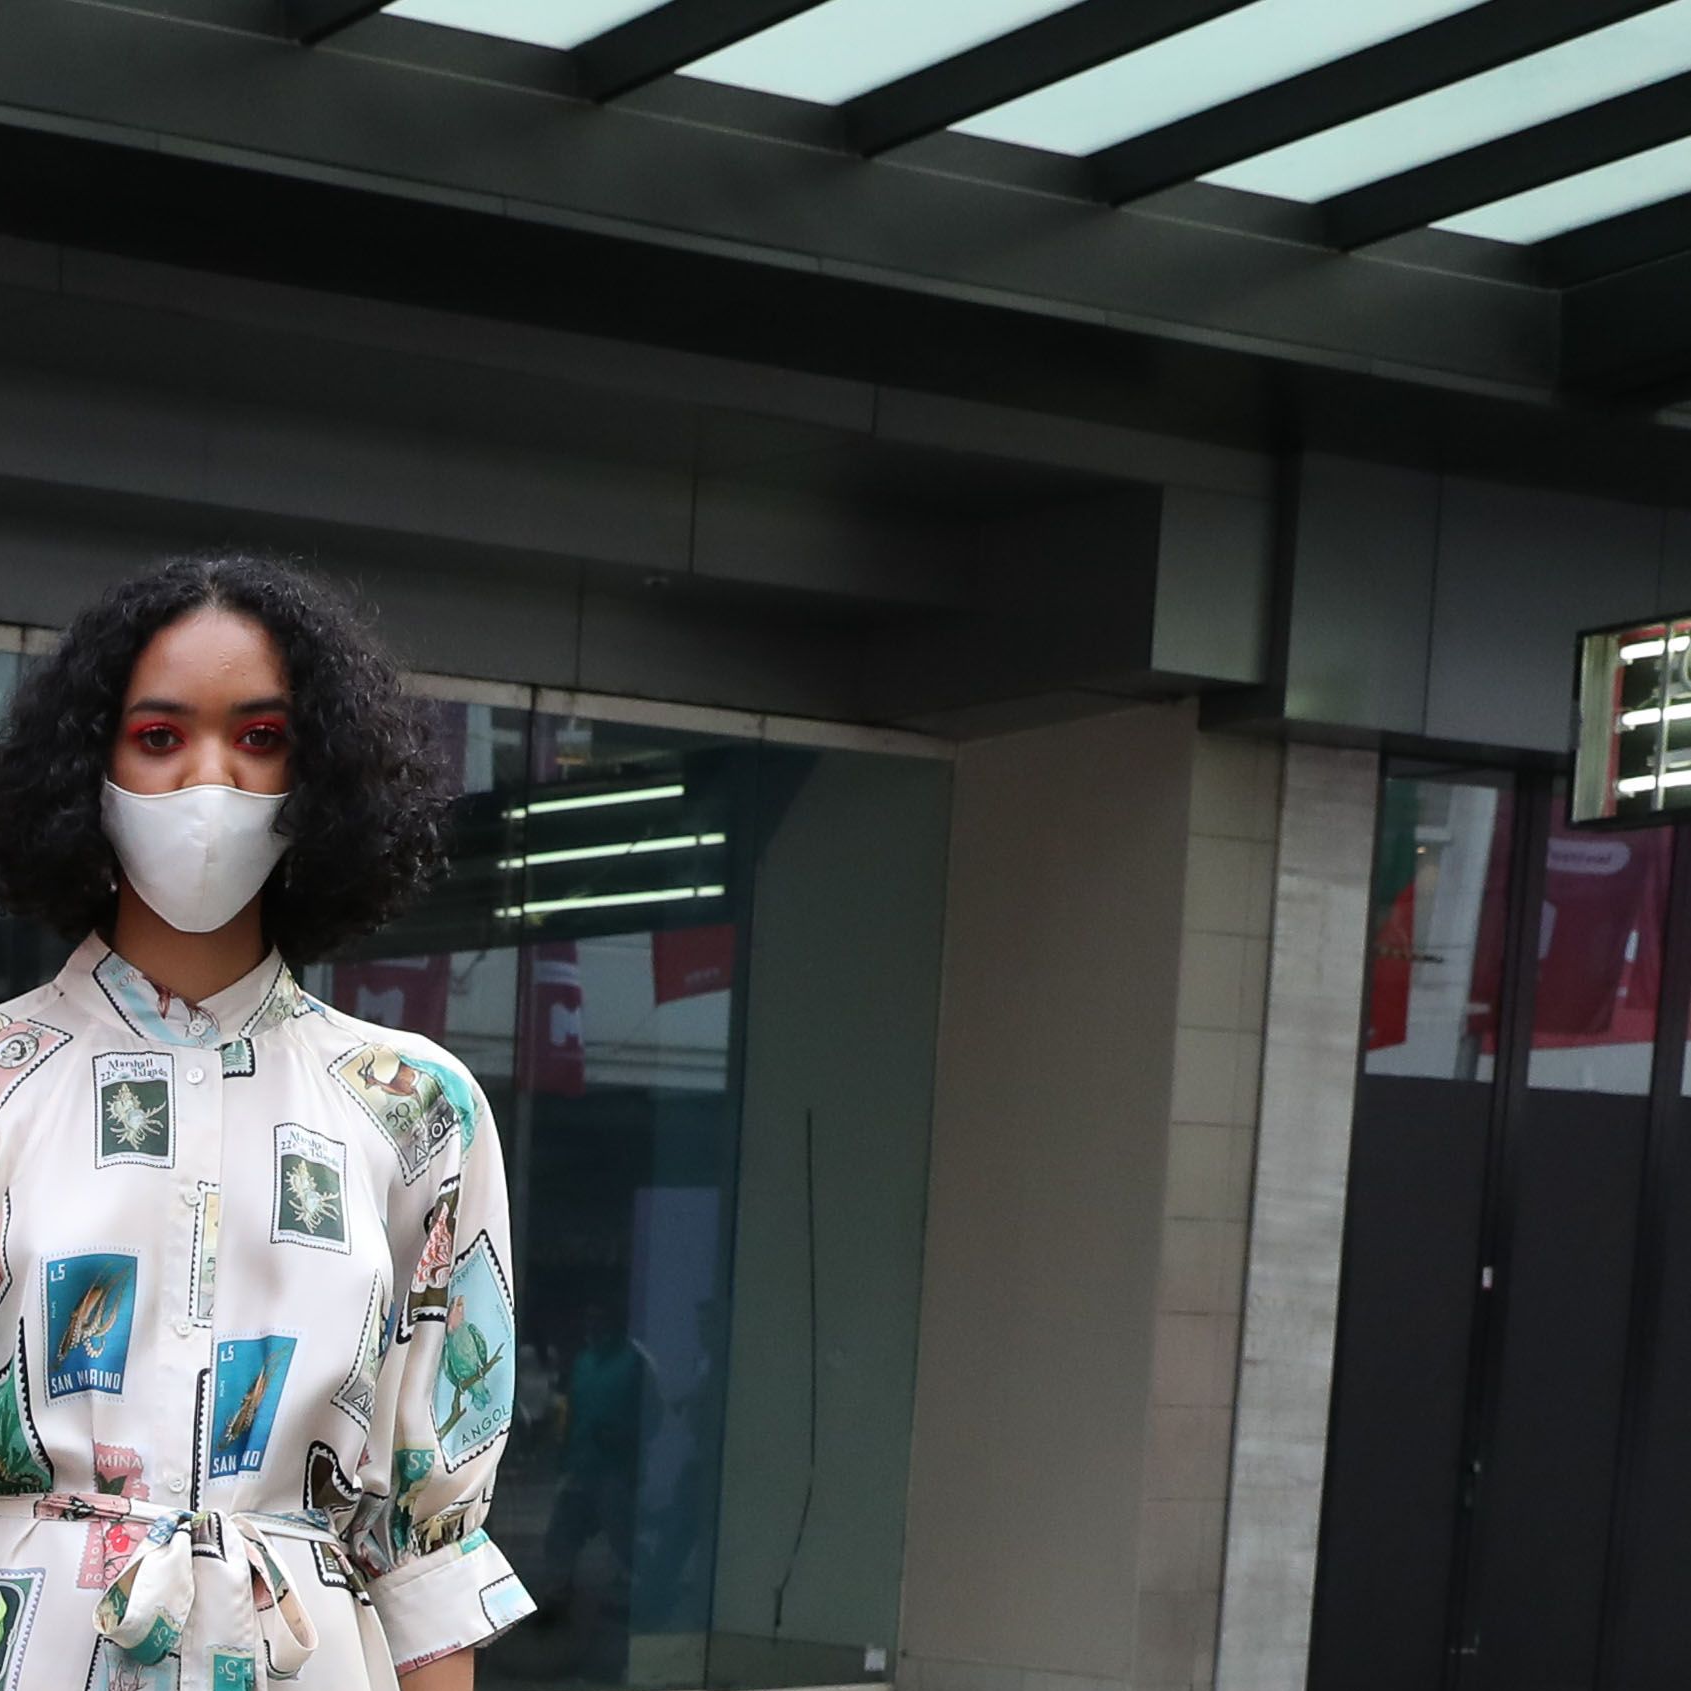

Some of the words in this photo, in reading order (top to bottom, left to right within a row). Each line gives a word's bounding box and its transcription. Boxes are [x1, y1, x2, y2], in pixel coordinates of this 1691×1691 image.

[107, 1057, 155, 1071] Marshall
[131, 1068, 168, 1079] Islands
[384, 1102, 411, 1129] 50
[50, 1373, 74, 1394] SAN
[460, 1405, 511, 1447] ANGOL
[212, 1453, 237, 1473] SAN
